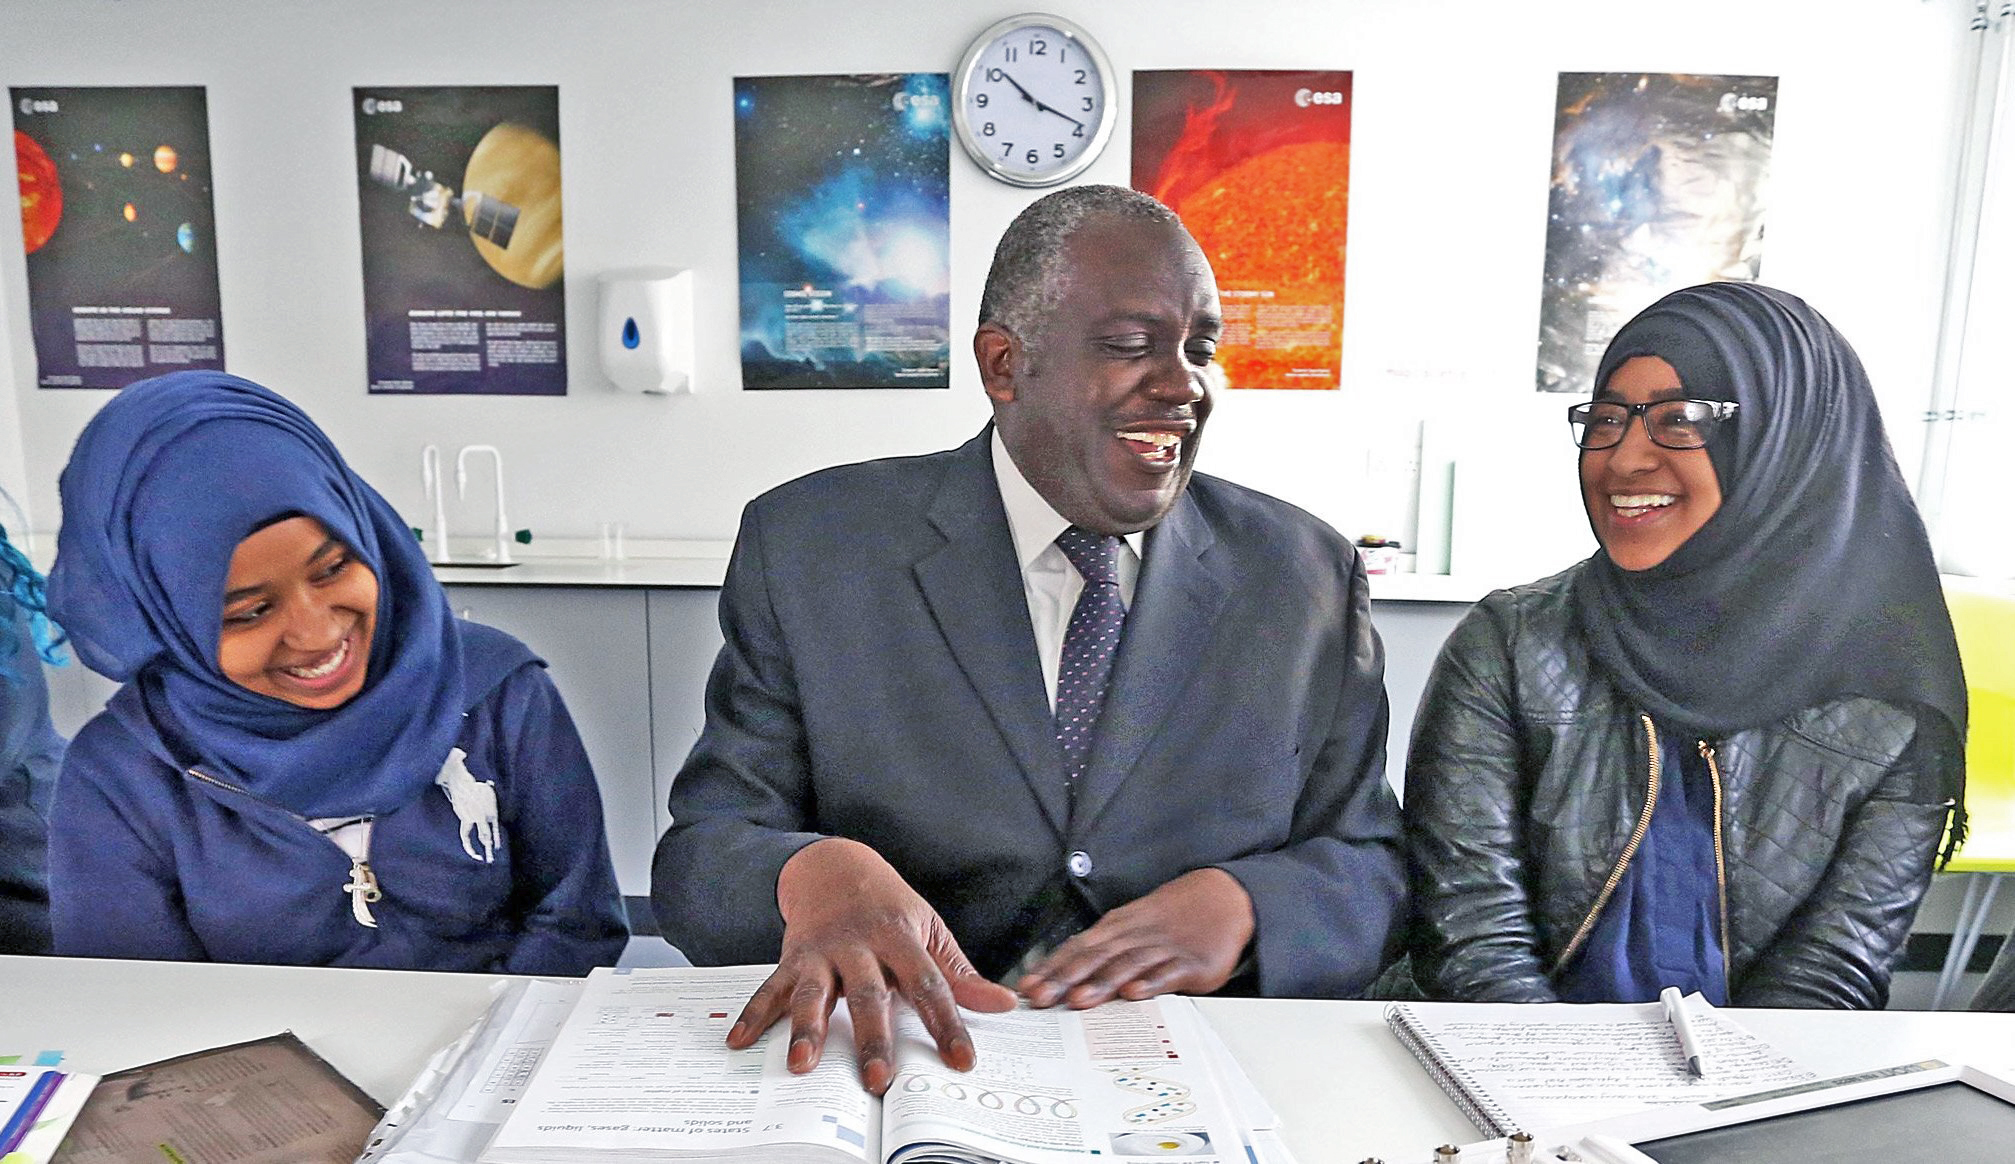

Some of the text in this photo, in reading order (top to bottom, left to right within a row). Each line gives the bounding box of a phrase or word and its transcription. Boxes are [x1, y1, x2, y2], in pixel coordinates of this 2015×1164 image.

[1005, 47, 1017, 62] 11
[1029, 40, 1047, 56] 12
[1060, 48, 1065, 63] 1
[986, 67, 1003, 82] 10
[1074, 69, 1087, 85] 2
[976, 93, 989, 108] 9
[1081, 97, 1093, 112] 3
[1312, 91, 1344, 105] esa
[982, 122, 996, 136] 8
[1072, 124, 1084, 138] 4
[1001, 142, 1014, 157] 7
[1026, 149, 1039, 164] 6
[1053, 144, 1065, 158] 5
[537, 1124, 583, 1132] liquids
[684, 1119, 723, 1127] solids
[706, 1126, 751, 1134] States
[688, 1127, 704, 1135] of
